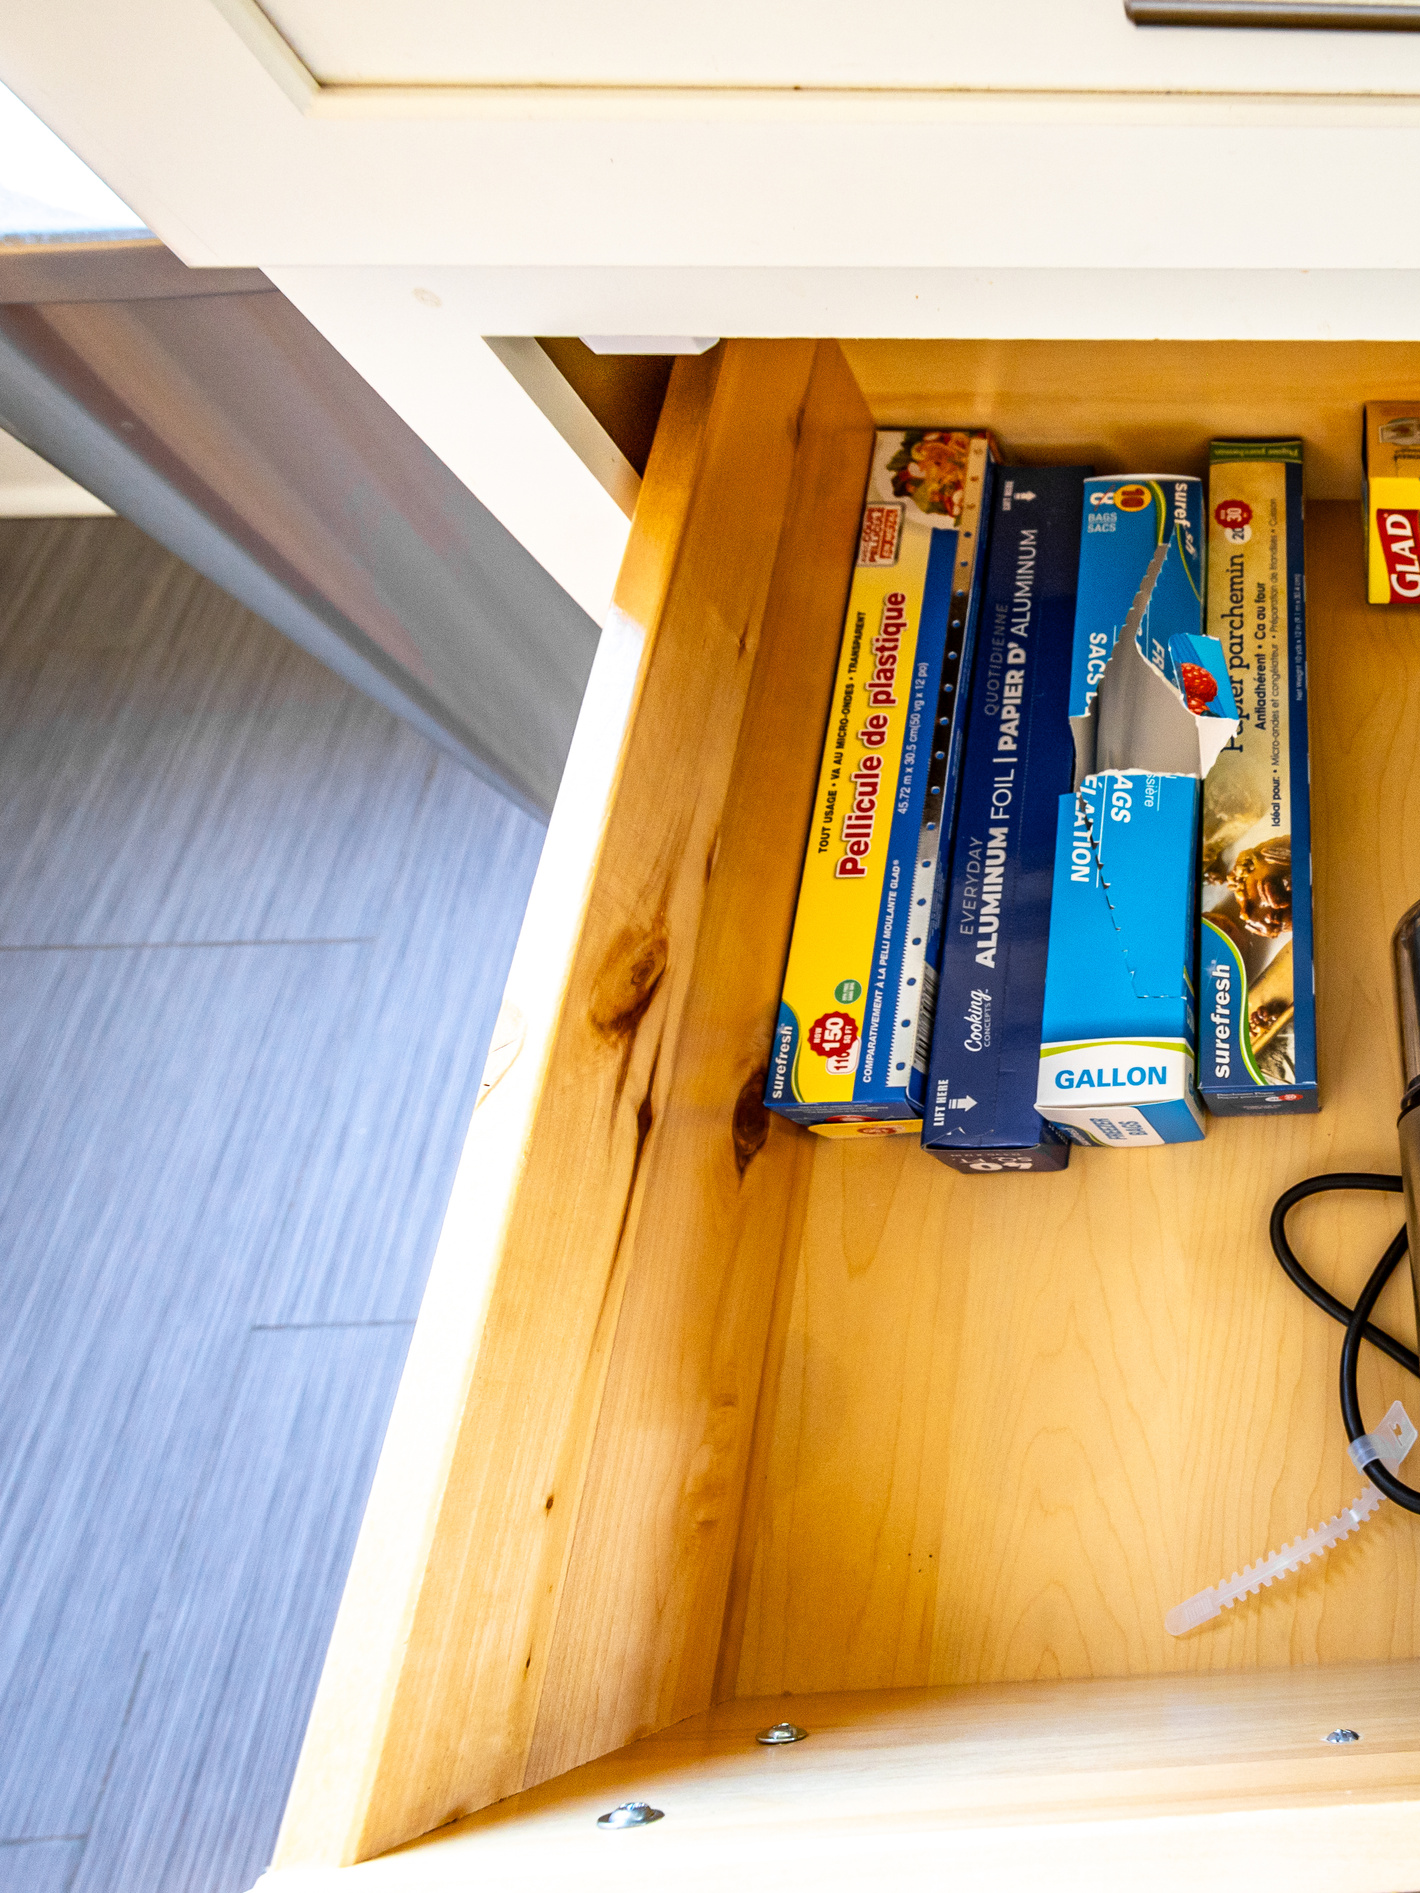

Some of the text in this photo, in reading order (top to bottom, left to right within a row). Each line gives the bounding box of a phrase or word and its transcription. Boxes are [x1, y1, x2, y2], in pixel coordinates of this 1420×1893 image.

[1087, 512, 1118, 522] BAGS
[1120, 488, 1145, 508] 10
[1226, 507, 1242, 522] 30
[1087, 522, 1117, 533] SACS
[1174, 482, 1198, 560] surefsh
[1220, 553, 1250, 670] parchemin
[1269, 589, 1280, 633] Préparation
[865, 591, 908, 707] plastique
[984, 603, 1008, 716] QUOTIDIENNE
[1086, 632, 1107, 685] SACS
[1254, 582, 1267, 731] Antiadhérent Ca au four
[1269, 644, 1281, 697] congélateur
[914, 678, 925, 690] 12
[1272, 697, 1280, 709] et
[818, 611, 866, 854] TOUT USAGE VA AU MICRO-ONDES TRANSPARENT
[858, 712, 888, 748] de
[975, 529, 1038, 968] ALUMINUM FOIL PAPIER D' ALUMINUM
[1270, 709, 1280, 766] Micro-ondes
[904, 744, 917, 765] 30.5
[897, 786, 912, 815] 45.72
[902, 775, 913, 785] m
[1110, 774, 1133, 824] AGS
[1144, 773, 1157, 807] ssière
[836, 754, 883, 877] Pellicule
[1271, 802, 1281, 827] Idéal
[960, 836, 983, 935] EVERYDAY
[883, 890, 898, 939] MOULANTE
[877, 967, 887, 980] LA
[879, 940, 890, 966] PELLI
[874, 981, 885, 990] À
[813, 1027, 822, 1043] NOW
[822, 1016, 845, 1051] 150
[843, 1025, 853, 1044] SQ FT
[862, 990, 883, 1083] COMPARATIVEMENT
[964, 988, 992, 1052] Cooking
[983, 1002, 992, 1048] CONCEPTS
[1210, 964, 1231, 1079] surefresh
[772, 1025, 794, 1099] surefresh
[1054, 1066, 1167, 1090] GALLON
[933, 1079, 949, 1127] LIFT HERE
